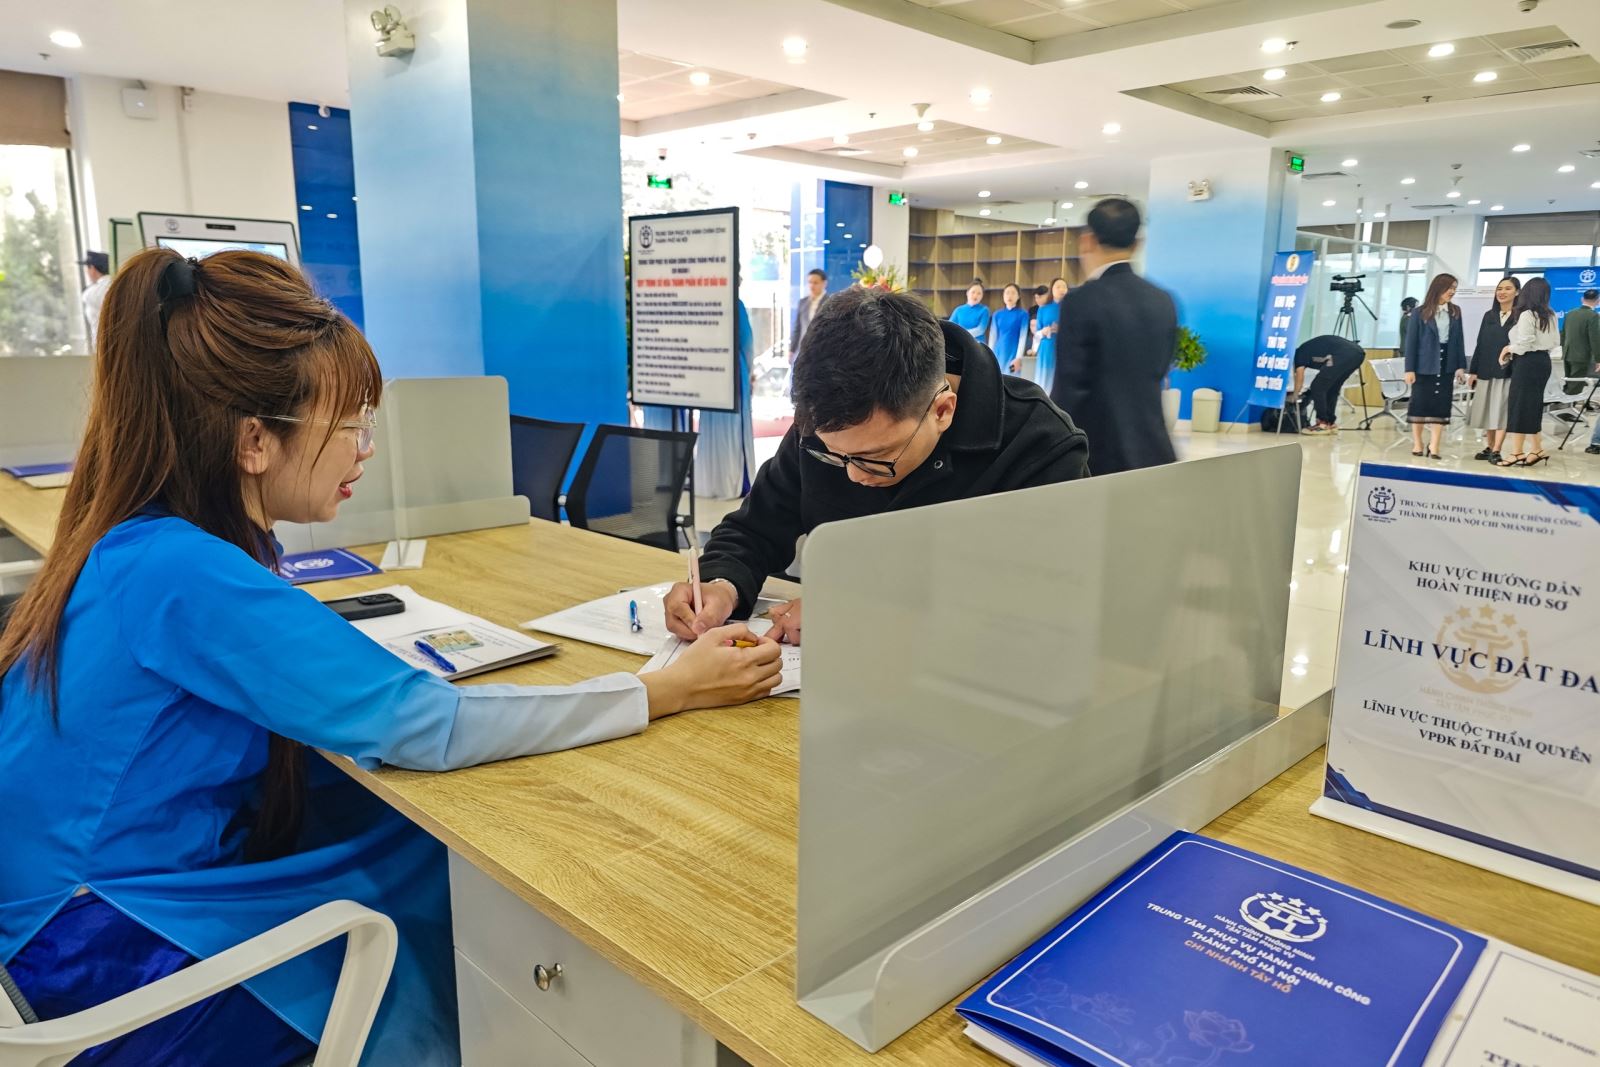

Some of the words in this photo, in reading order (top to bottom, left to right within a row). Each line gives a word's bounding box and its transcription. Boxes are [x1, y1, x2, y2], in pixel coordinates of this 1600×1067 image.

[1399, 509, 1427, 519] THÀNH
[1429, 512, 1447, 521] PHỐ
[1449, 515, 1462, 524] HÀ
[1464, 517, 1480, 527] NỘI
[1481, 520, 1499, 528] CHI
[1500, 521, 1534, 533] NHÁNH
[1535, 525, 1549, 535] SỐ
[1400, 499, 1428, 509] TRUNG
[1431, 502, 1449, 511] TÂM
[1451, 505, 1475, 514] PHỤC
[1478, 508, 1490, 517] VỤ
[1492, 509, 1519, 519] HÀNH
[1520, 513, 1552, 523] CHÍNH
[1553, 516, 1583, 527] CÔNG
[1408, 560, 1441, 575] KHU
[1445, 566, 1478, 580] VỰC
[1481, 571, 1542, 592] HƯỚNG
[1416, 576, 1460, 593] HOÀN
[1463, 584, 1513, 603] THIỆN
[1516, 592, 1541, 607] HỒ
[1544, 598, 1569, 612] SƠ
[1363, 628, 1424, 657] LĨNH
[1432, 643, 1489, 669] VỰC
[1495, 655, 1553, 683] ĐẤT
[1560, 668, 1600, 695] ĐA
[1363, 699, 1395, 717] LĨNH
[1399, 708, 1429, 724] VỰC
[1431, 715, 1483, 738] THUỘC
[1486, 727, 1532, 749] THẨM
[1419, 728, 1457, 747] VPĐK
[1460, 738, 1492, 757] ĐẤT
[1494, 746, 1522, 764] ĐAI
[1146, 902, 1182, 921] TRUNG
[1183, 915, 1208, 932] TÂM
[1207, 926, 1239, 946] PHỤC
[1240, 940, 1259, 954] VỤ
[1257, 947, 1293, 971] HÀNH
[1293, 966, 1334, 990] CHÍNH
[1333, 983, 1371, 1006] CÔNG
[1184, 938, 1205, 952] CHI
[1204, 948, 1249, 973] NHÁNH
[1249, 969, 1274, 985] TÂY
[1272, 980, 1292, 994] HỒ
[1191, 930, 1230, 953] THÀNH
[1231, 949, 1258, 965] PHỐ
[1257, 961, 1276, 975] HÀ
[1277, 969, 1301, 986] NỘI
